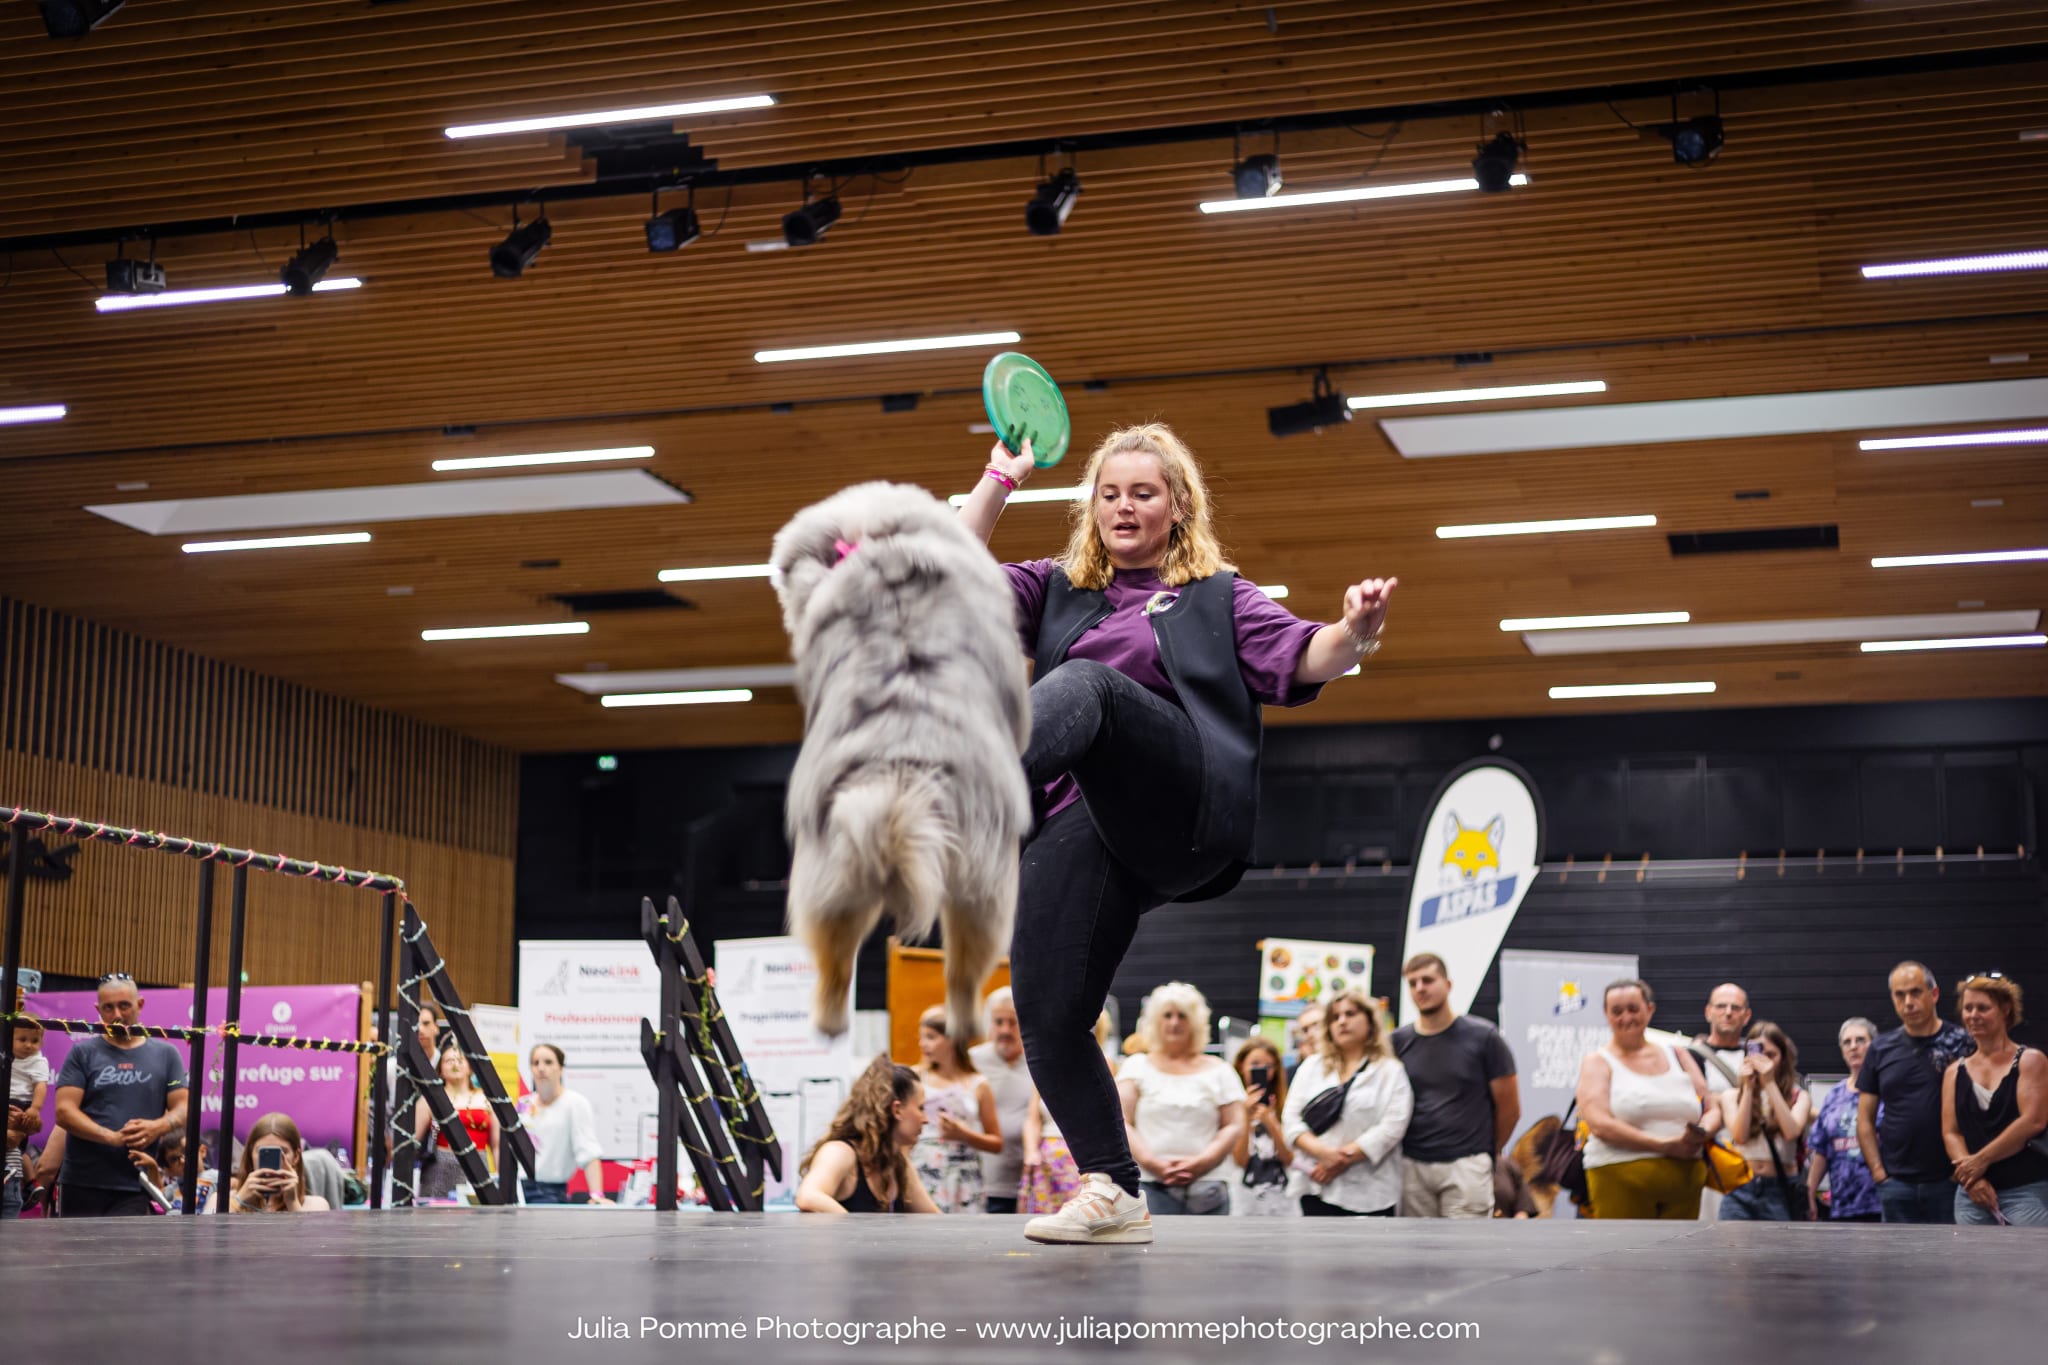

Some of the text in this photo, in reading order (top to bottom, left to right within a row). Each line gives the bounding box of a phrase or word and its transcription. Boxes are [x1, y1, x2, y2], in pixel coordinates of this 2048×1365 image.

[1434, 880, 1498, 922] ASPAS
[239, 1064, 305, 1086] refuge
[309, 1065, 343, 1082] sur
